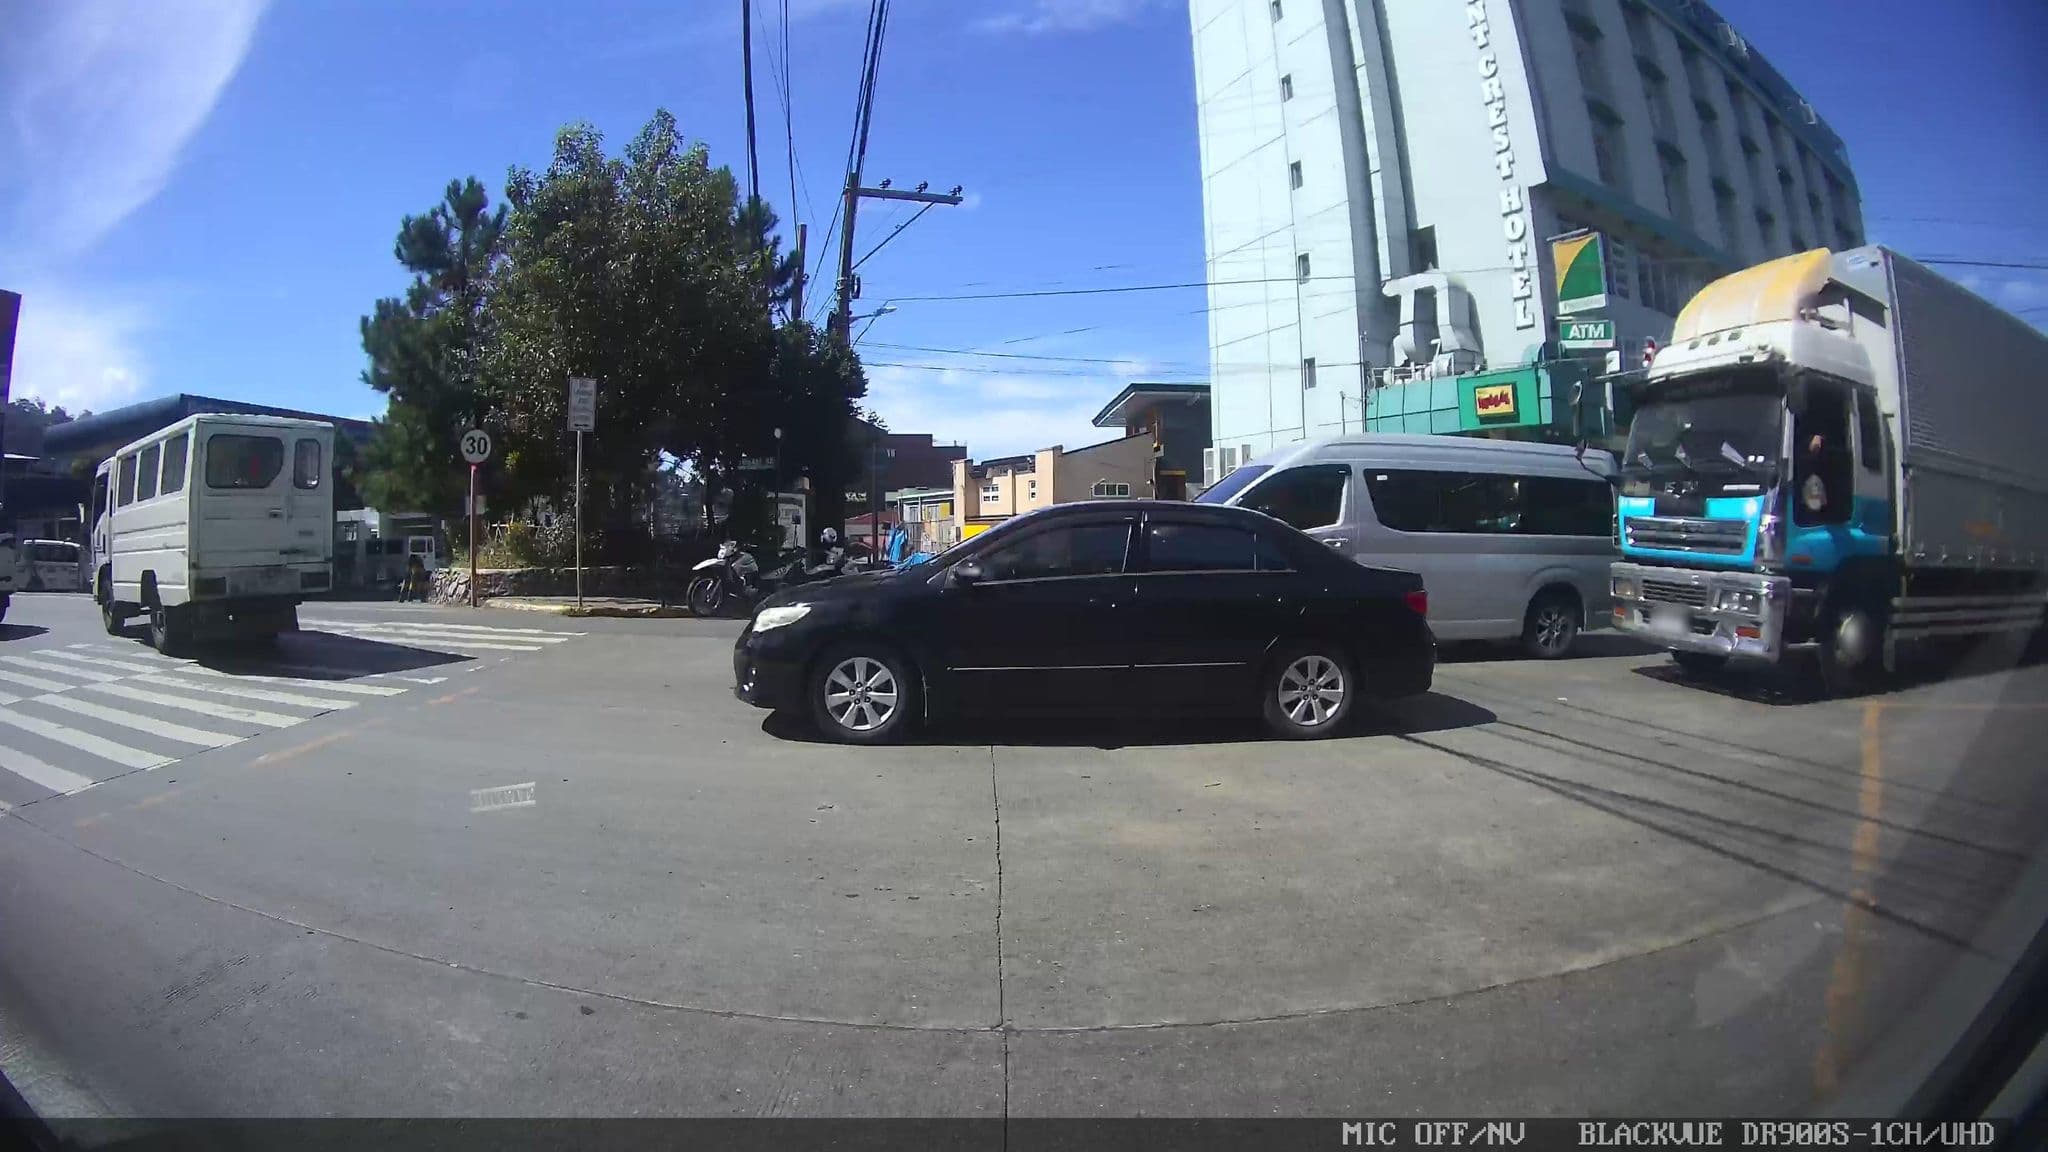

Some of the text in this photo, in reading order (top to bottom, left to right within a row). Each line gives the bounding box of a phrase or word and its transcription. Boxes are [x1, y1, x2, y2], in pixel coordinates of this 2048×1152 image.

[1466, 0, 1535, 331] NT CREST HOTEL
[1568, 323, 1605, 339] ATM
[465, 436, 488, 455] 30
